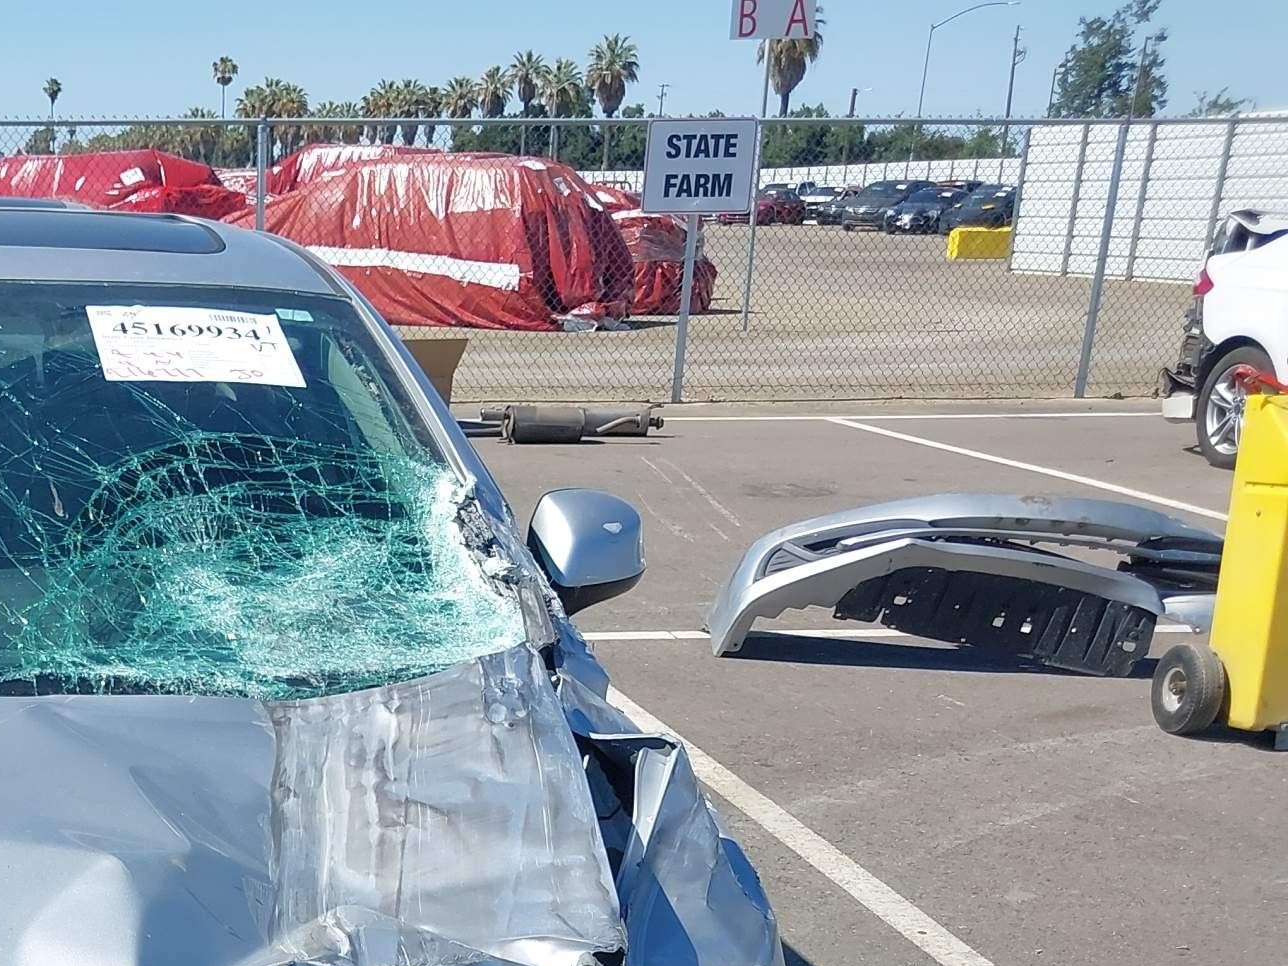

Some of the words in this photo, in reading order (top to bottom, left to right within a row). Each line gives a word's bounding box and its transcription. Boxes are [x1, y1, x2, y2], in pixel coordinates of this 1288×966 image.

[738, 0, 757, 37] B
[784, 0, 809, 36] A
[665, 133, 738, 159] STATE
[663, 173, 733, 198] FARM
[111, 320, 261, 341] 45169934
